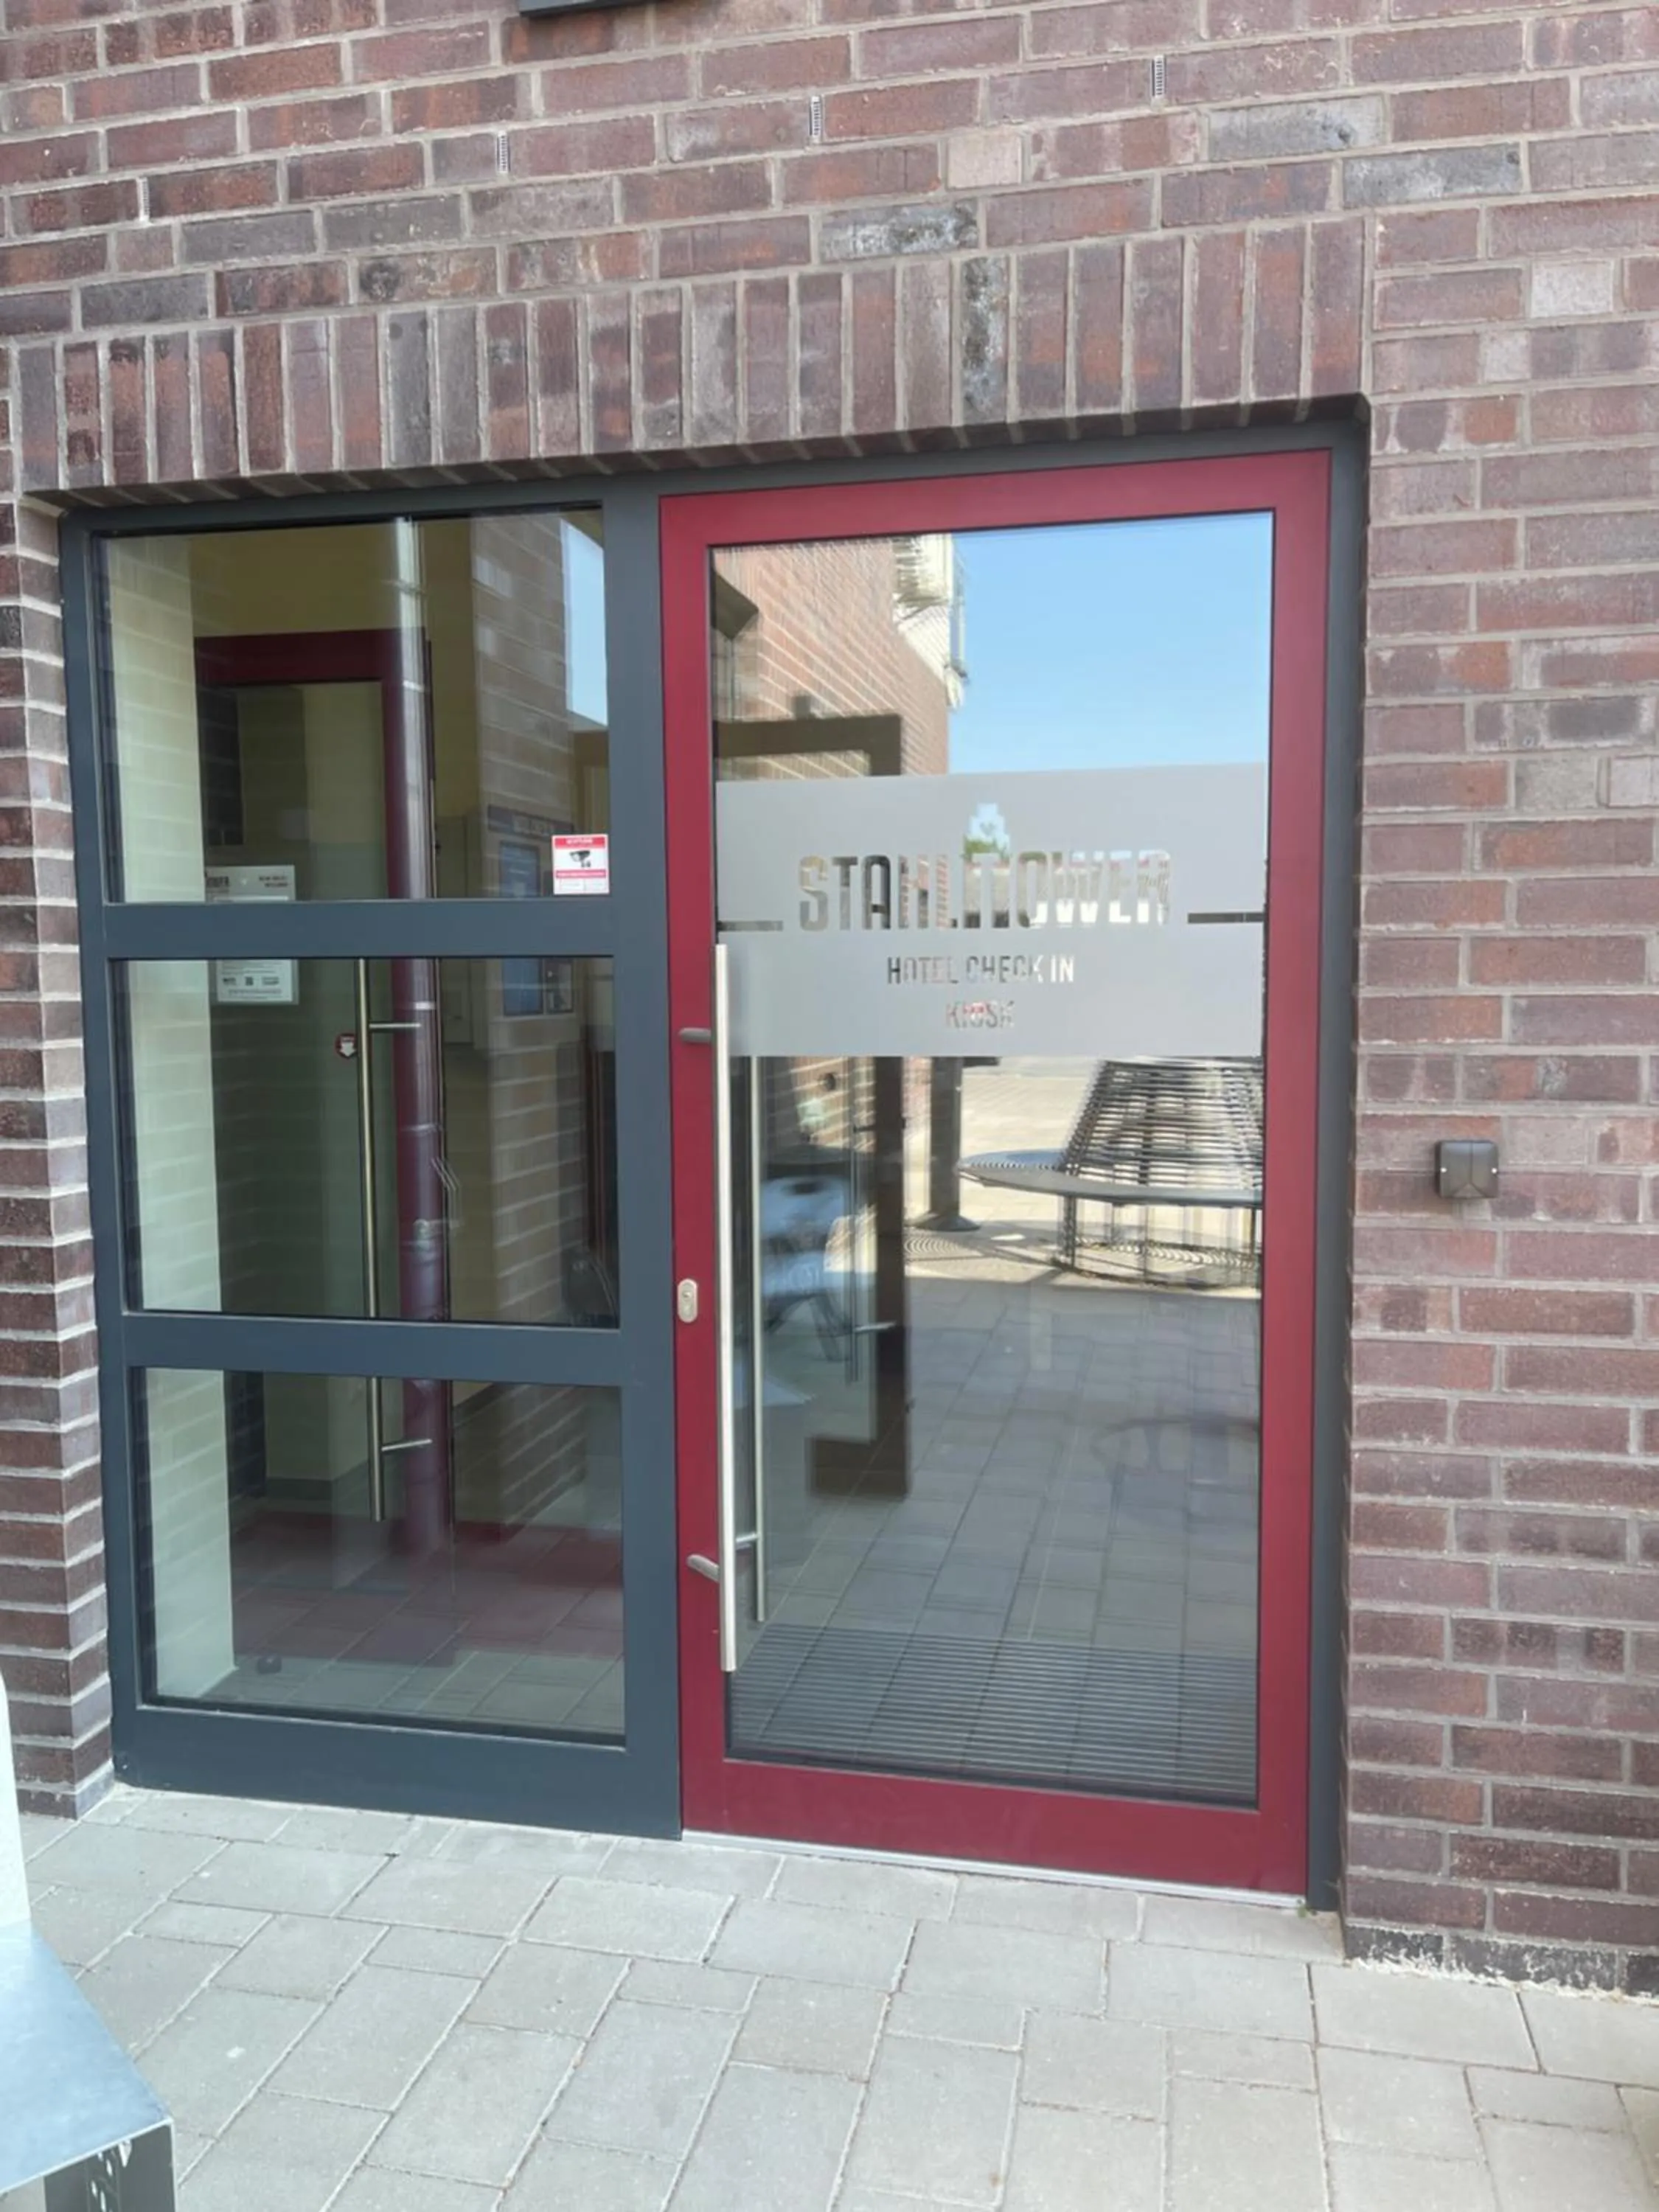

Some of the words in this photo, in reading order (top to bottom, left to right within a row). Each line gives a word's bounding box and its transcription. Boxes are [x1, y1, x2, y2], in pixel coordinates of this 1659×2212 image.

[888, 956, 959, 984] HOTEL
[966, 956, 1044, 984] CHECK
[1050, 955, 1074, 983] IN
[946, 1000, 1015, 1028] KIOSK
